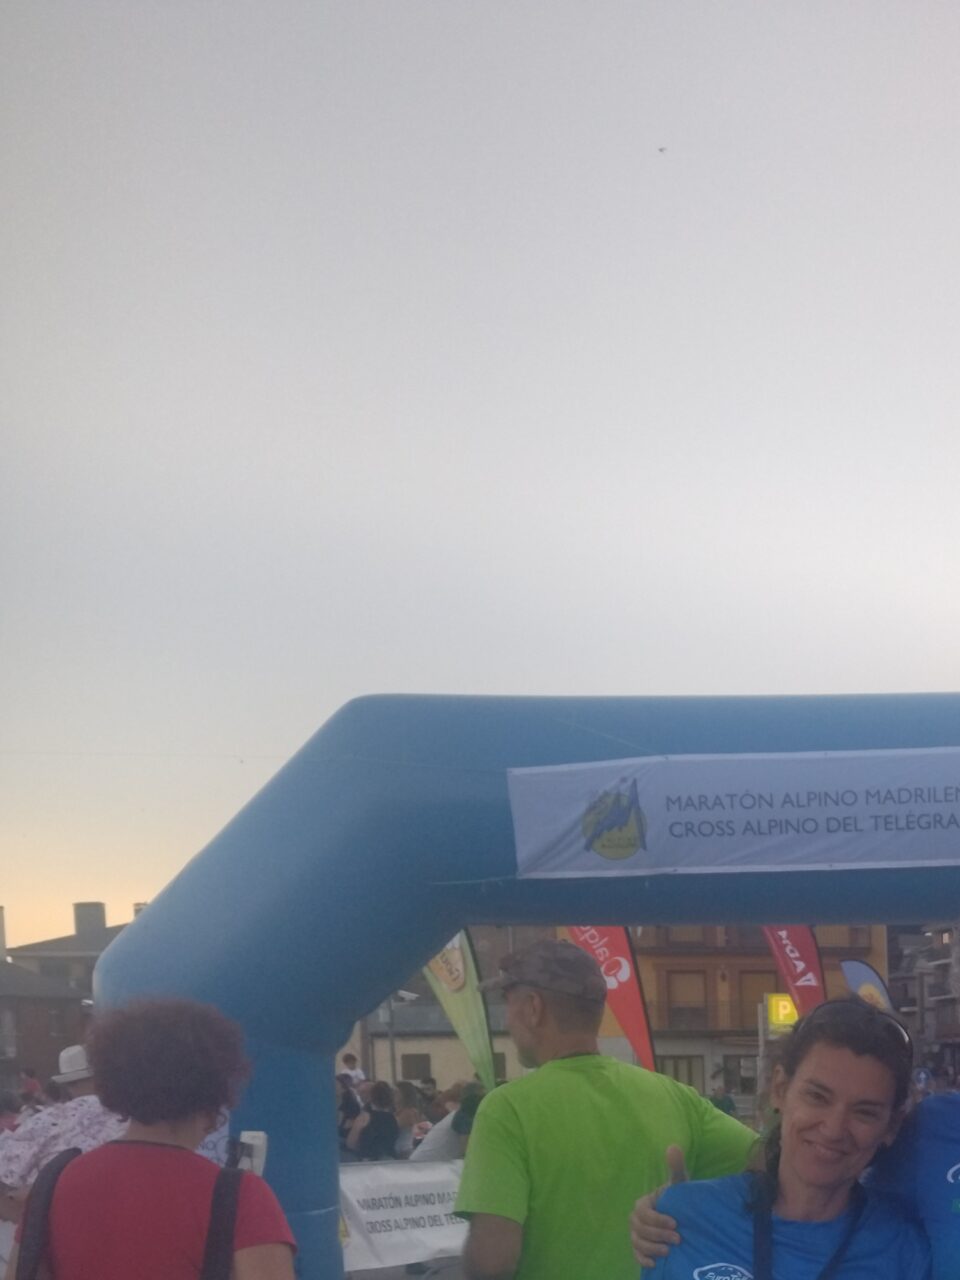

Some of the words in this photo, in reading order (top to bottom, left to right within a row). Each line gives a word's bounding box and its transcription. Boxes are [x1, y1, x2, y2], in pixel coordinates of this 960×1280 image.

[666, 789, 774, 812] MARATÓN
[780, 789, 858, 809] ALPINO
[668, 820, 736, 839] CROSS
[742, 817, 819, 836] ALPINO
[826, 815, 864, 833] DEL
[404, 1192, 436, 1207] ALPINO
[366, 1220, 393, 1234] CROSS
[394, 1216, 426, 1230] ALPINO
[428, 1214, 445, 1228] DEL
